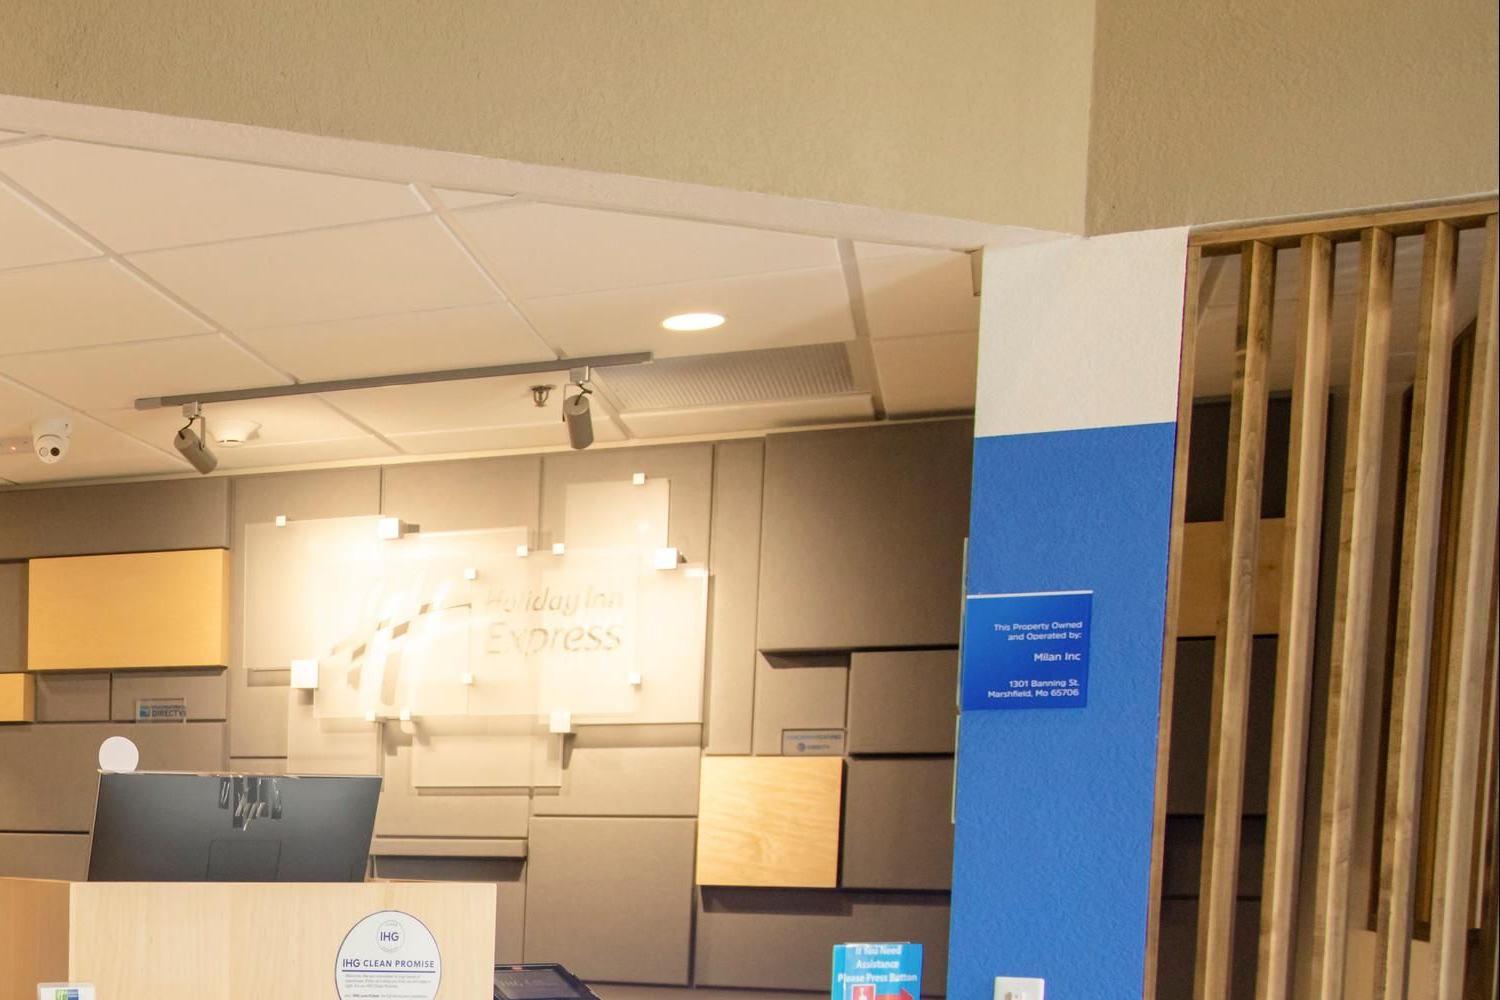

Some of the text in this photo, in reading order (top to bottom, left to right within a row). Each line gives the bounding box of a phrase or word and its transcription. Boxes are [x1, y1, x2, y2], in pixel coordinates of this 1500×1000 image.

[484, 586, 581, 617] Hoiday
[994, 621, 1083, 632] This Property Owned
[485, 621, 623, 657] Express
[1007, 631, 1083, 641] and Operated by:
[1033, 652, 1081, 662] Milan Inc
[1009, 680, 1029, 688] 1301
[1031, 679, 1067, 688] Banning
[987, 688, 1080, 698] Marshfield, Mo 65706
[380, 931, 400, 942] IHG
[864, 945, 878, 955] You
[879, 945, 902, 955] Need
[342, 959, 435, 968] IHG CLEAN PROMISE
[856, 960, 900, 969] Assistance
[838, 973, 918, 983] Please Press Button
